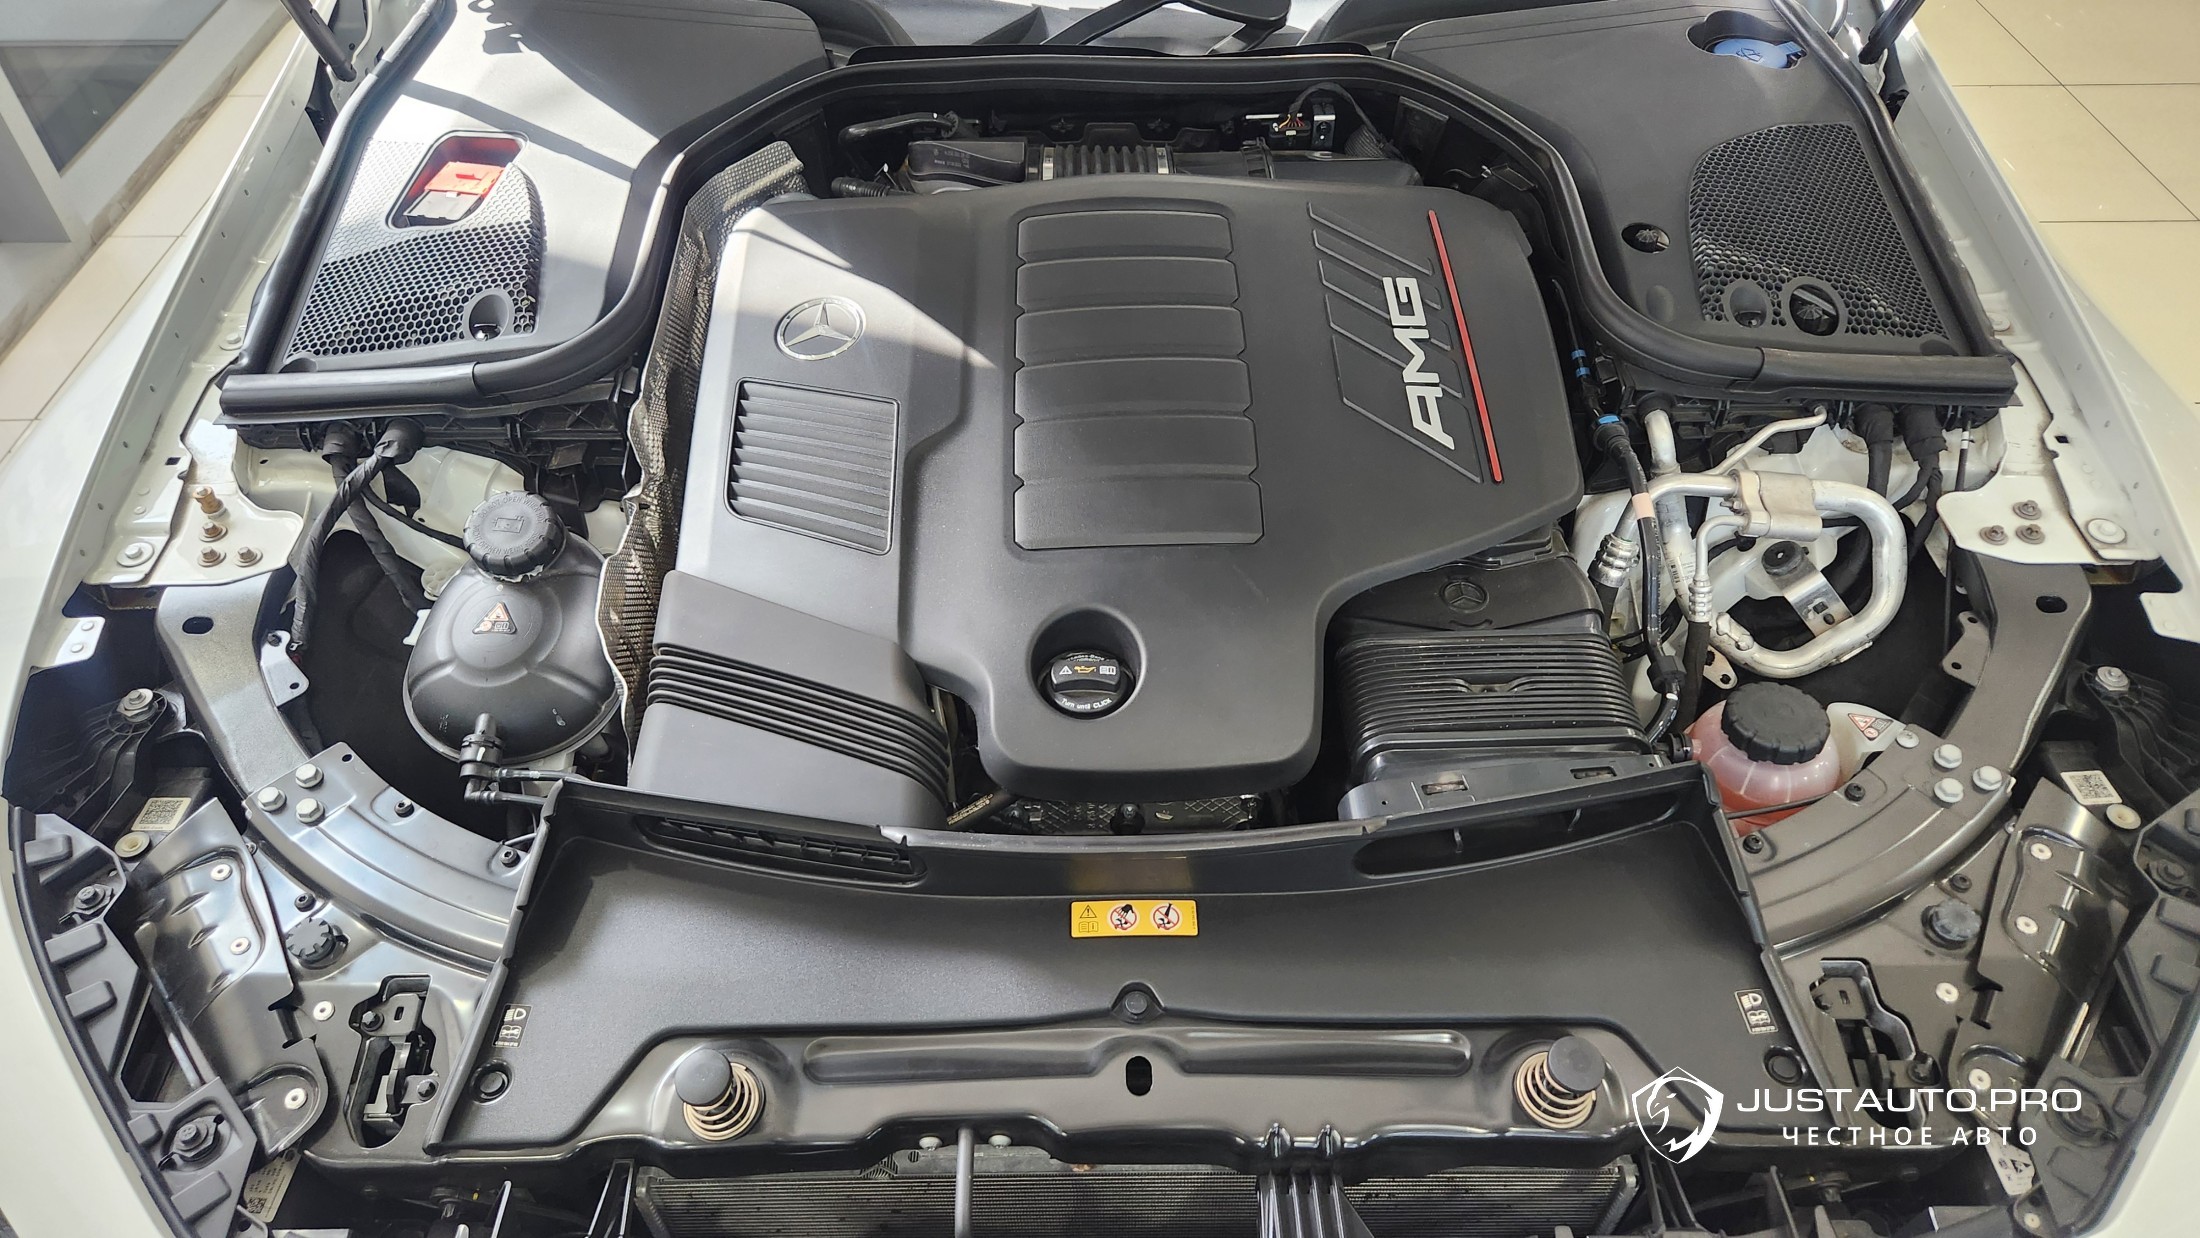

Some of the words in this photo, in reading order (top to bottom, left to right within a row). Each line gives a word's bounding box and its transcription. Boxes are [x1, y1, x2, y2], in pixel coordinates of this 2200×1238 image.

[1383, 277, 1455, 450] AMG
[503, 496, 523, 504] OPEN
[1062, 698, 1075, 708] Turn
[1093, 697, 1112, 709] CLICK
